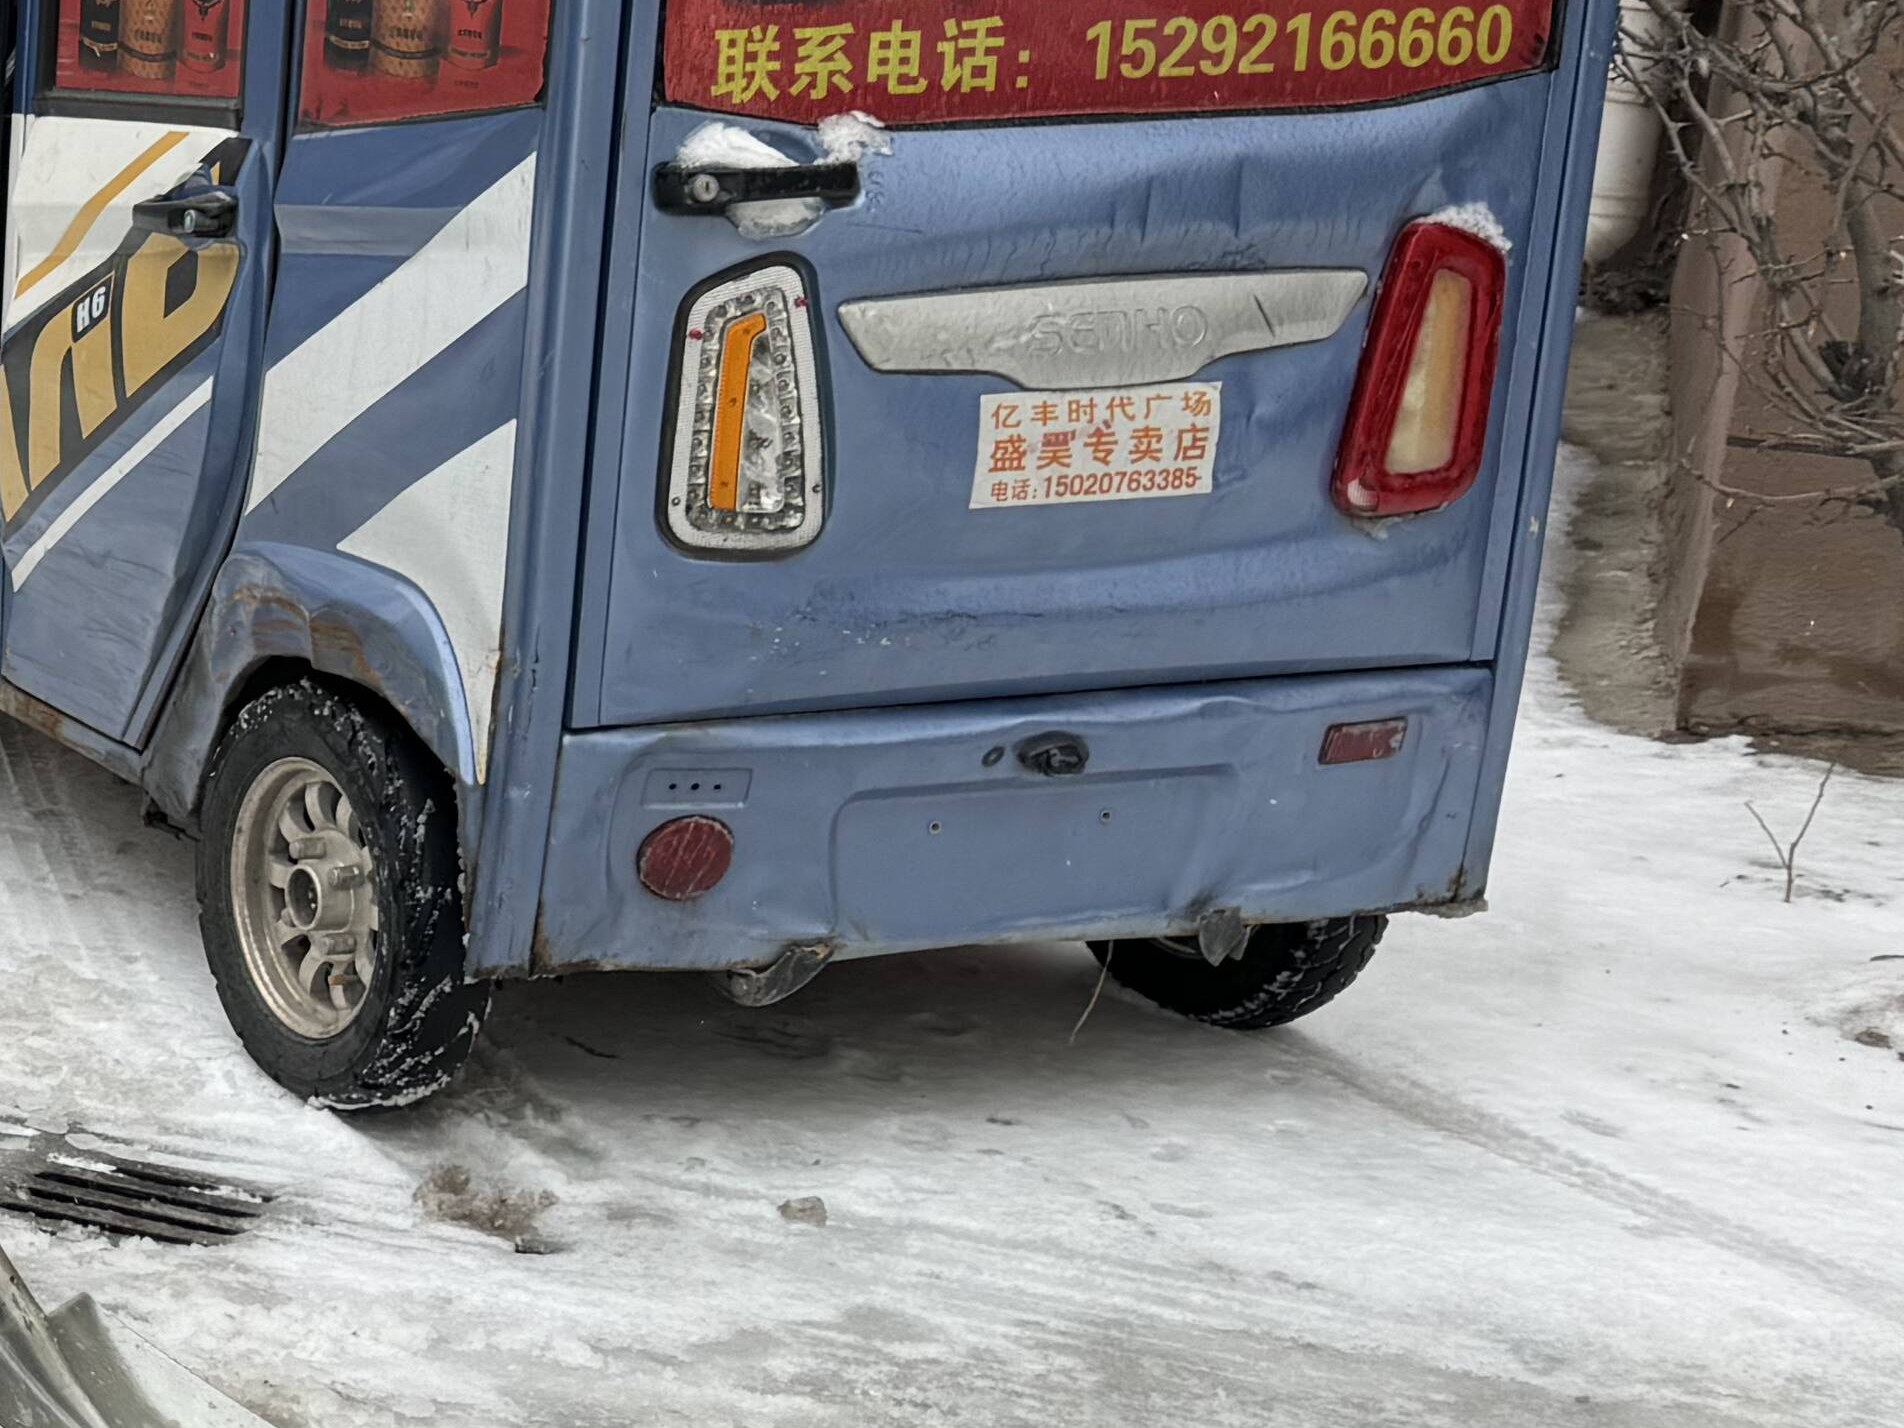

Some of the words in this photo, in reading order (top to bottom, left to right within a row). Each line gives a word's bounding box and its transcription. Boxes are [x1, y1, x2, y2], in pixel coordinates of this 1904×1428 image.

[710, 15, 1031, 105] 联系电话：
[1086, 3, 1513, 81] 15292166660
[76, 286, 106, 336] H6
[991, 390, 1213, 430] 亿丰时代广场
